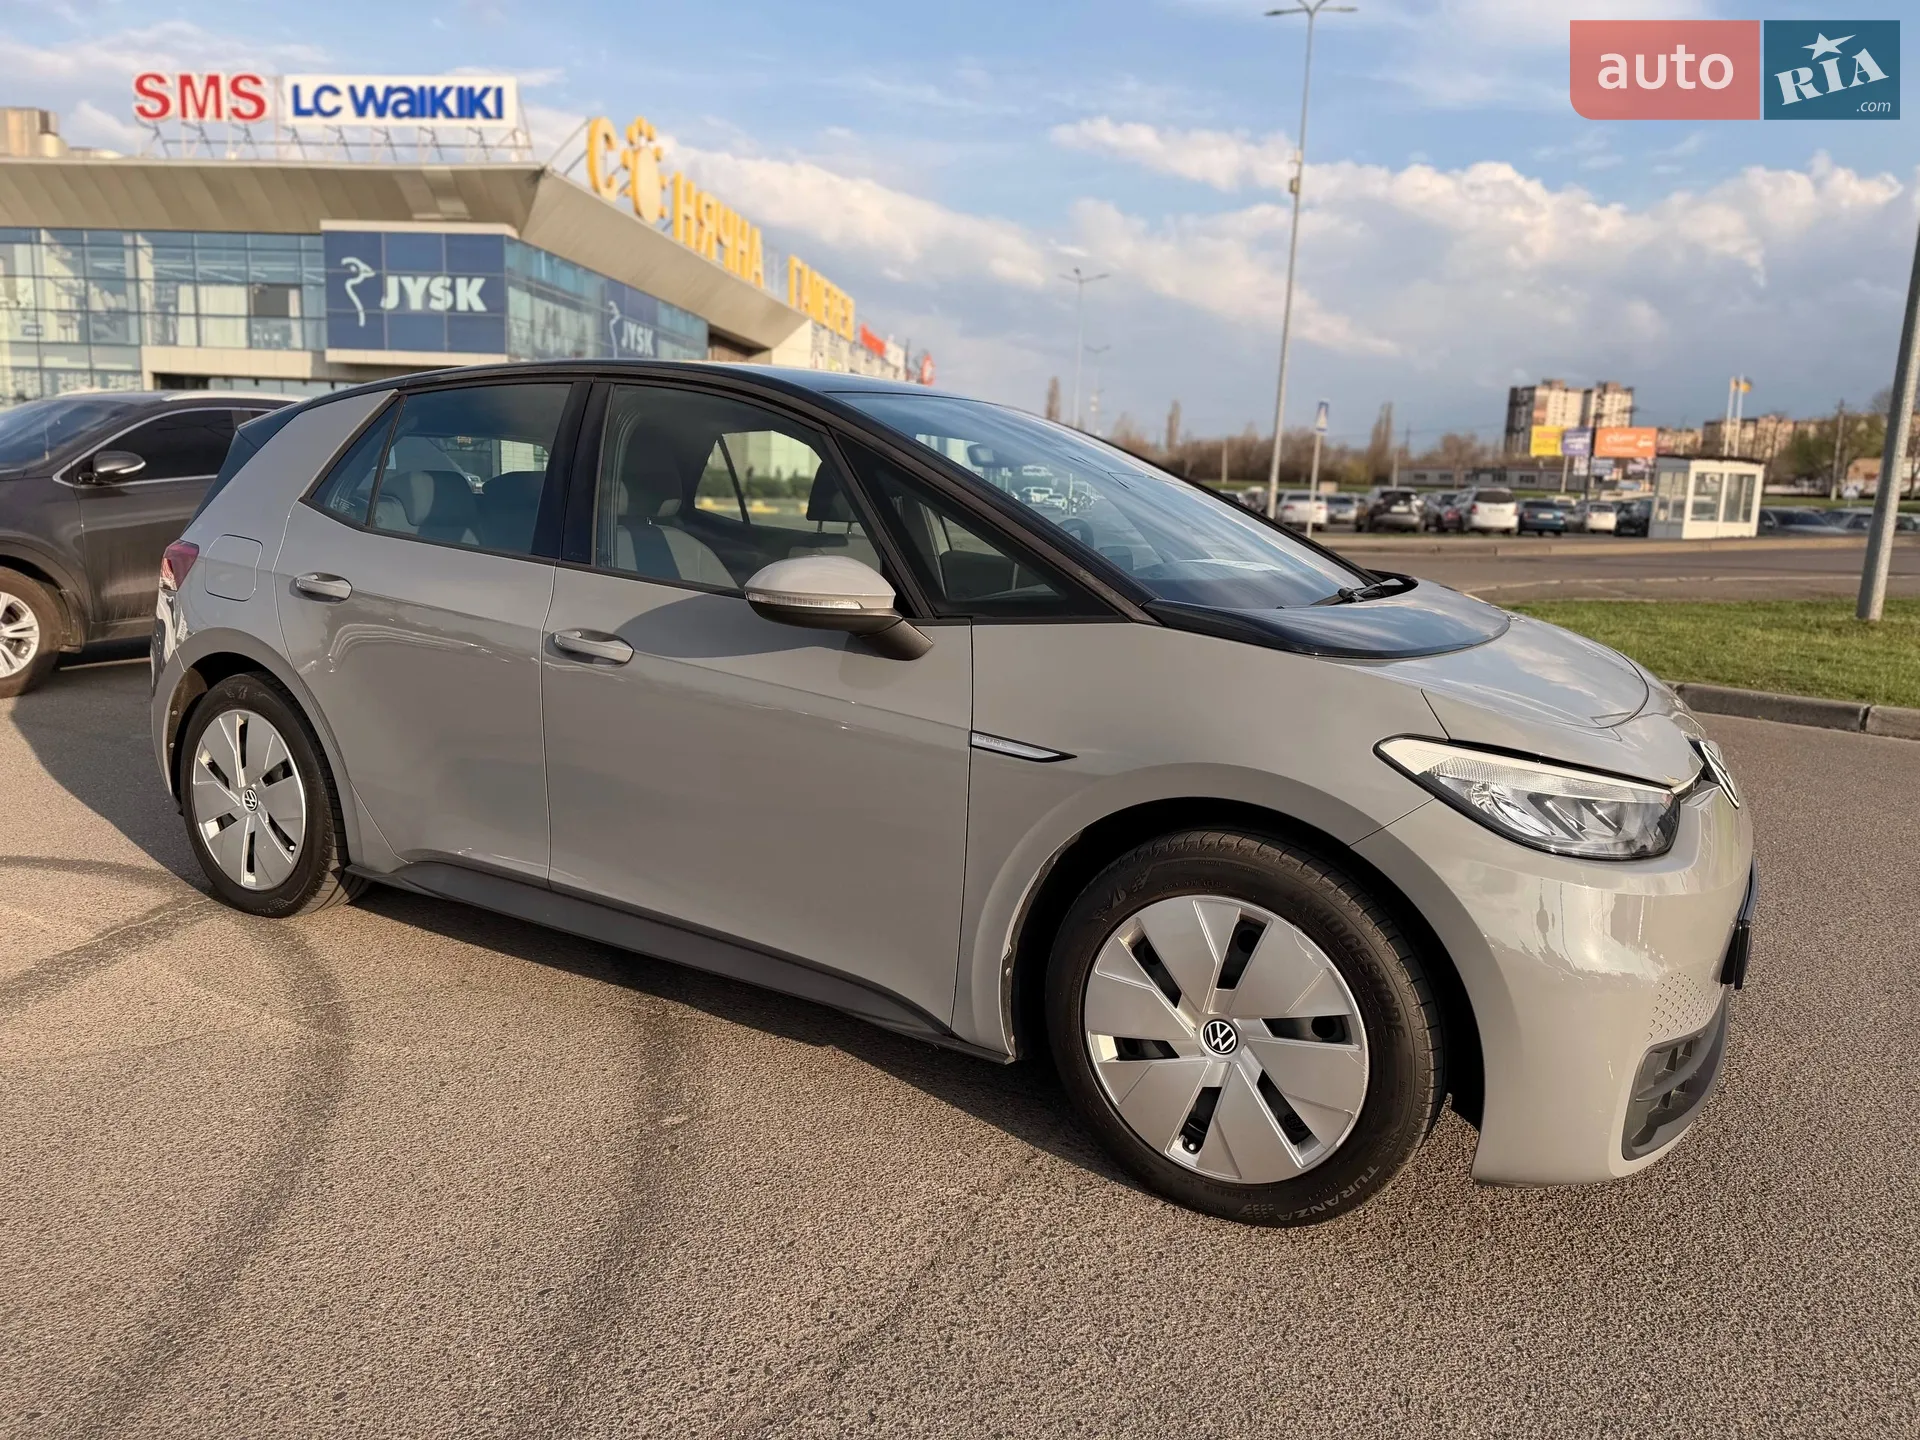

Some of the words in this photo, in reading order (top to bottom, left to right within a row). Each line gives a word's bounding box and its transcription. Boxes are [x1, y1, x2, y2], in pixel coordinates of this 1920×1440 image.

[134, 73, 268, 121] SMS
[292, 84, 342, 118] LC
[380, 276, 488, 312] JYSK
[621, 320, 654, 357] JYSK
[1276, 1165, 1381, 1222] TURANZA
